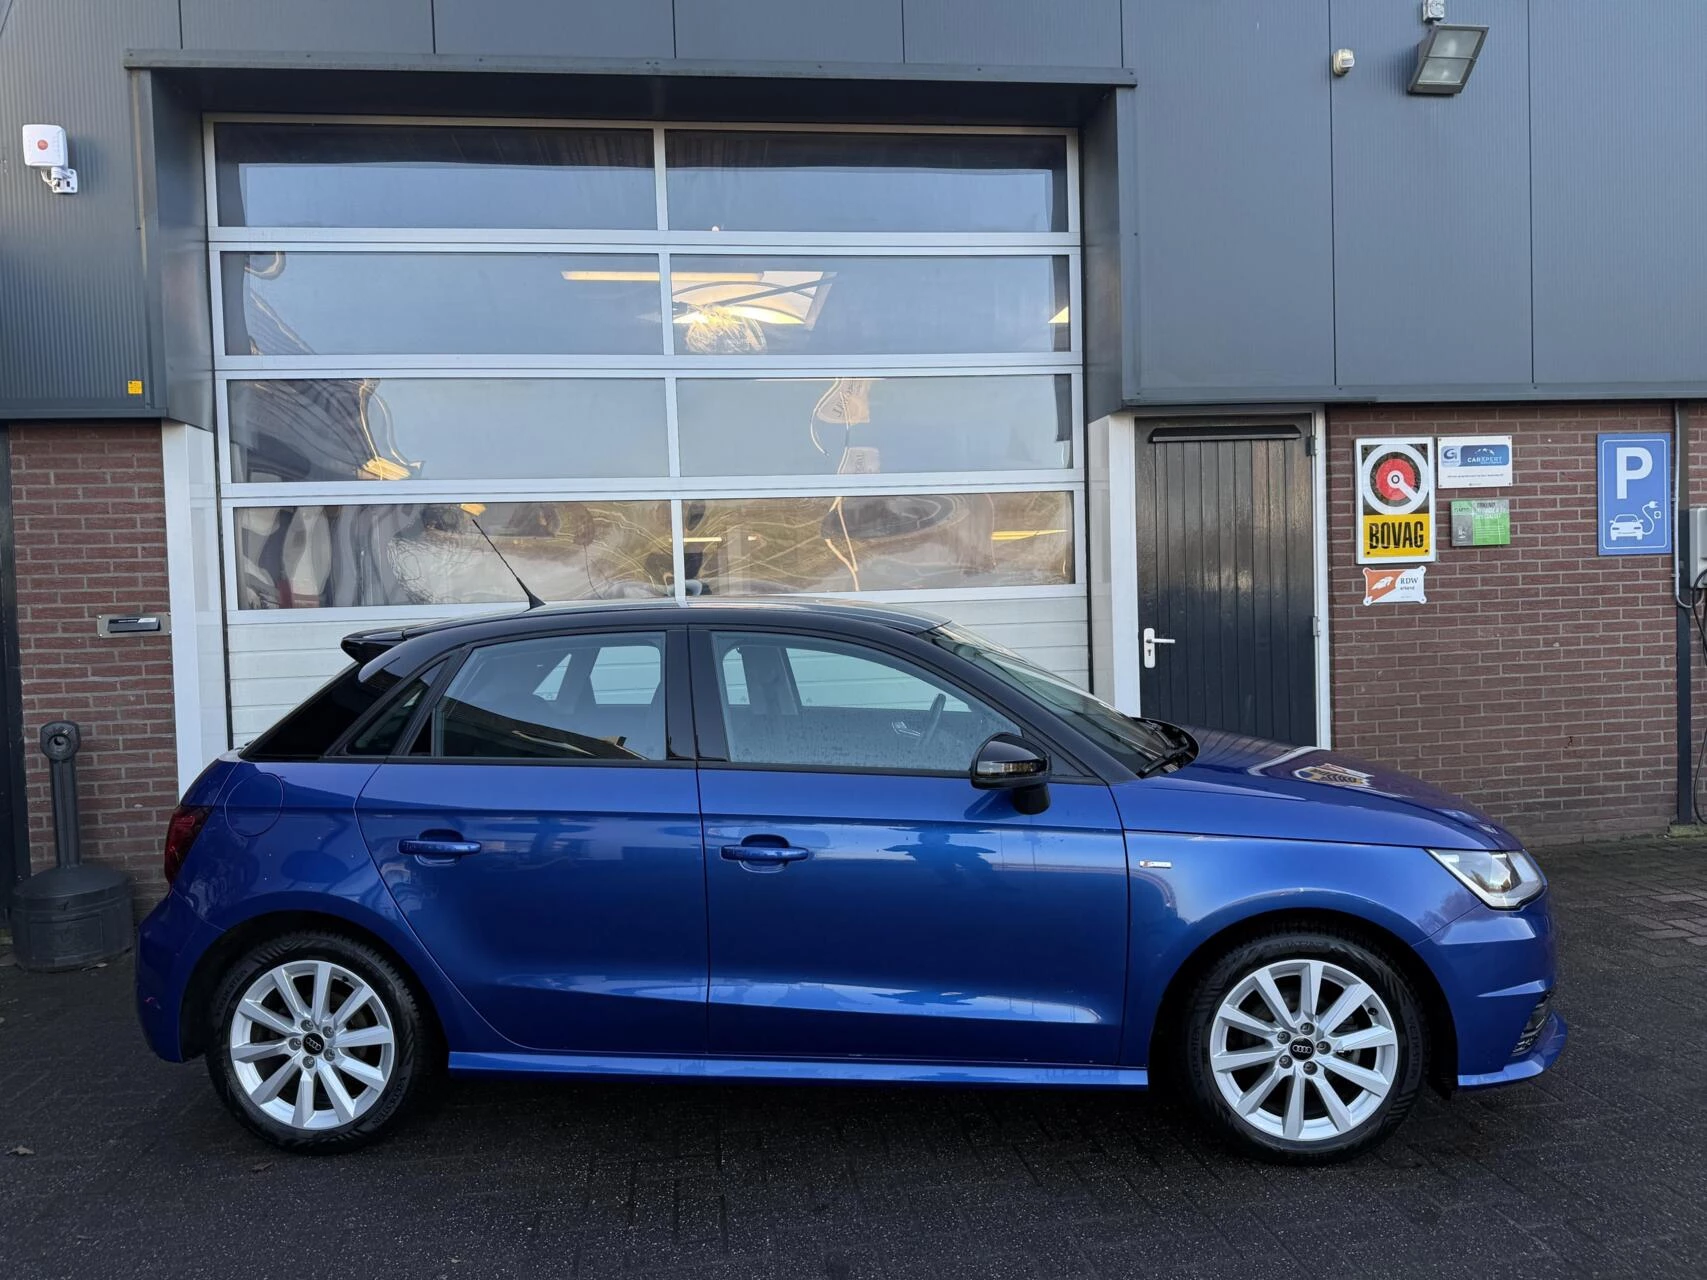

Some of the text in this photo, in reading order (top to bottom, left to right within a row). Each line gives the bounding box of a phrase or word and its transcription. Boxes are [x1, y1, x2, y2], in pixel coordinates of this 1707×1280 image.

[1616, 447, 1653, 499] P
[1369, 521, 1424, 549] BOVAG
[1400, 577, 1419, 585] RDW
